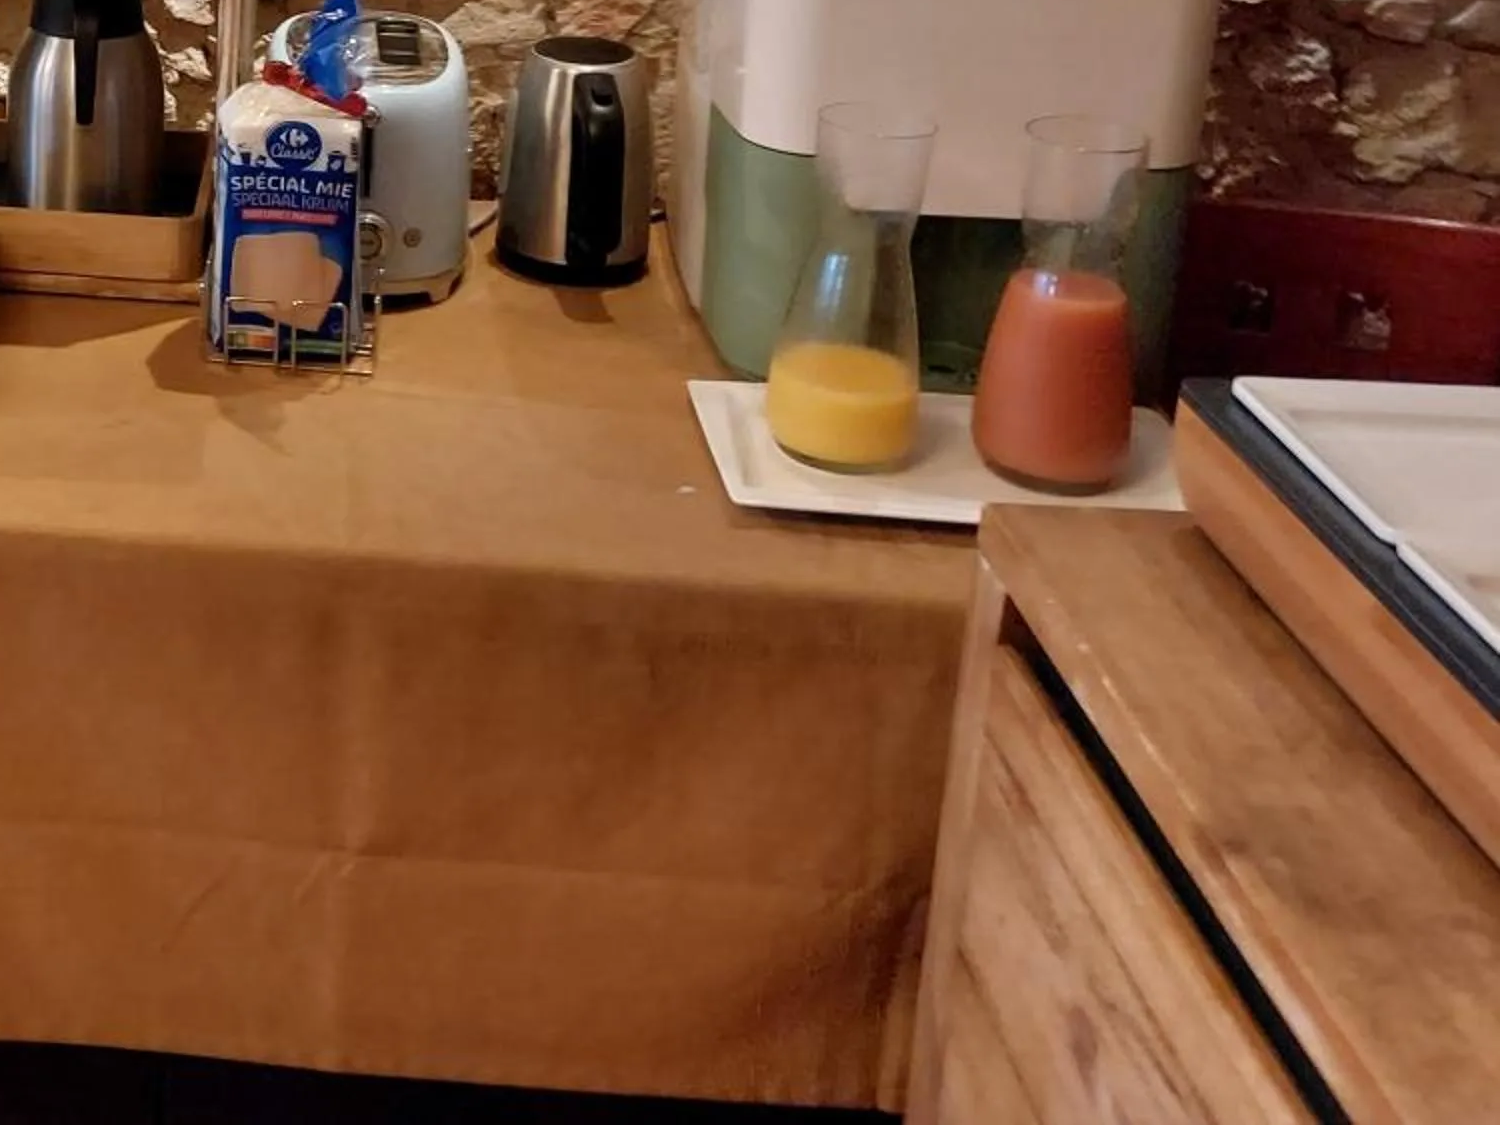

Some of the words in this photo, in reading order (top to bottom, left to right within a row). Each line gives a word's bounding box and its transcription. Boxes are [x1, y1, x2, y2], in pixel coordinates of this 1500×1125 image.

[230, 172, 310, 194] SPÉCIAL
[316, 180, 354, 198] MIE
[232, 192, 299, 208] SPECIAAL
